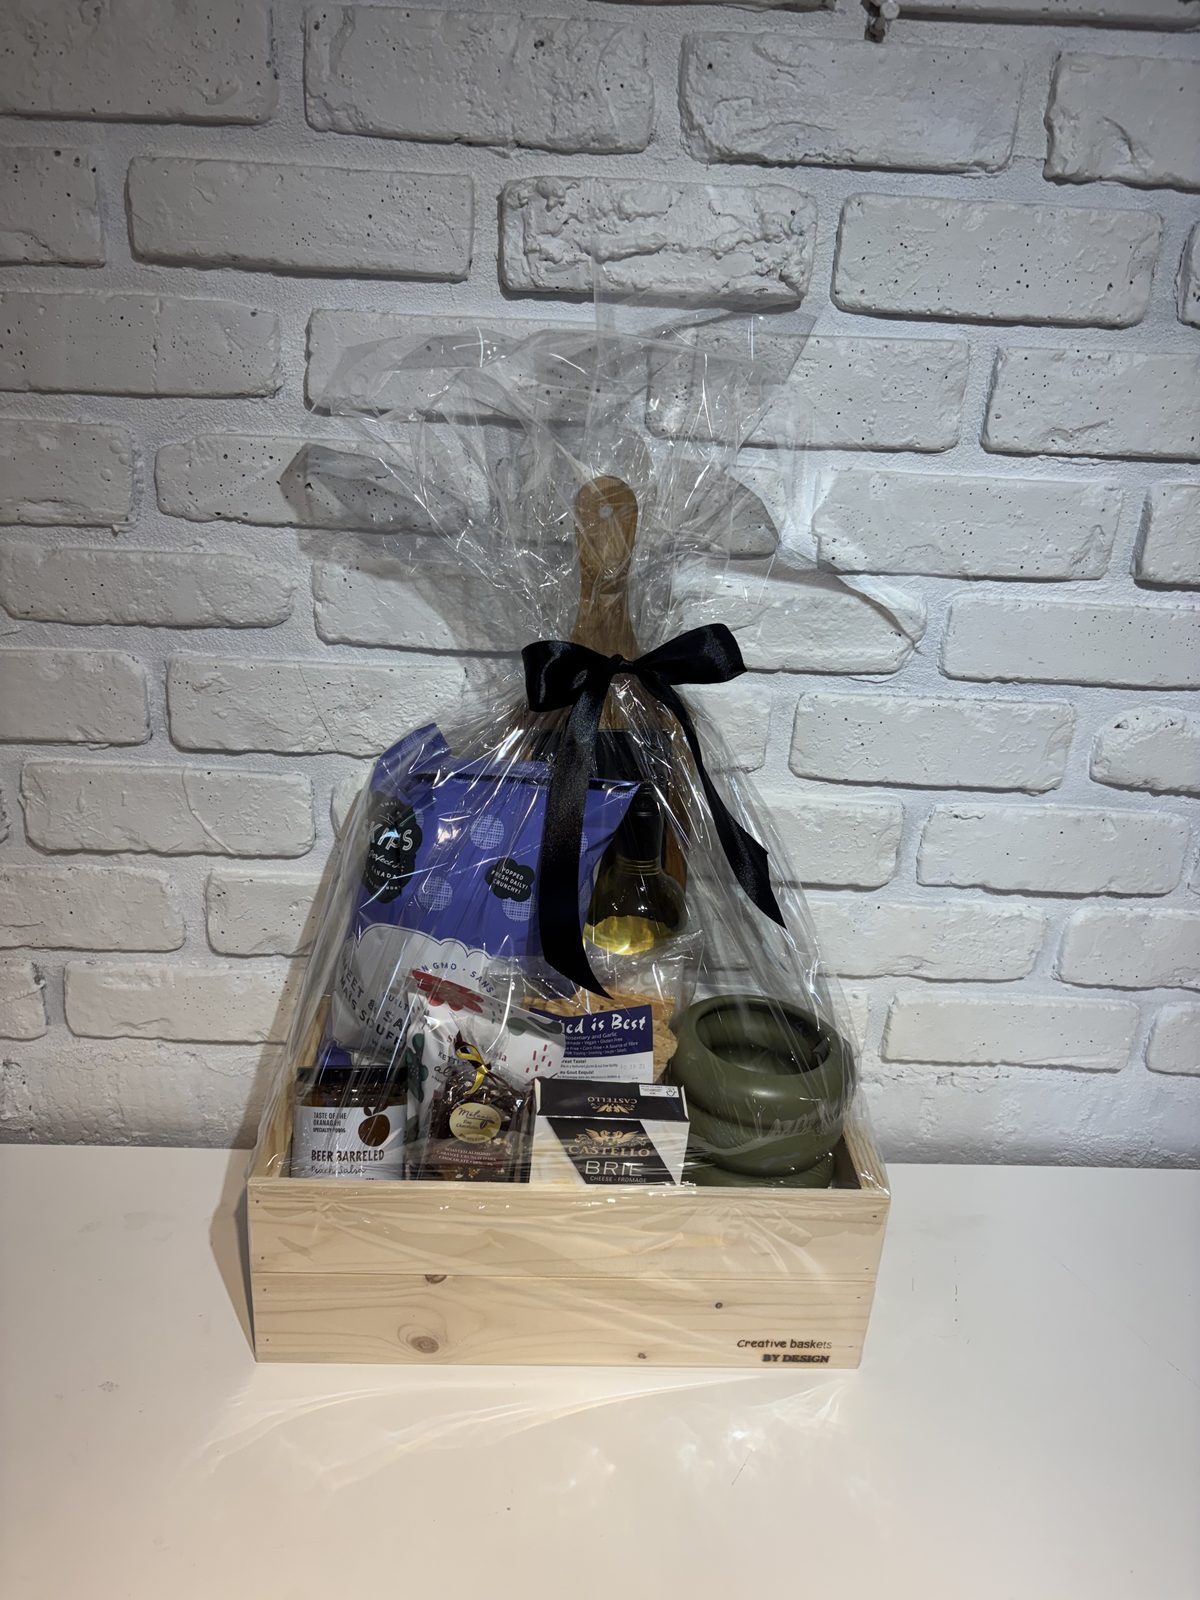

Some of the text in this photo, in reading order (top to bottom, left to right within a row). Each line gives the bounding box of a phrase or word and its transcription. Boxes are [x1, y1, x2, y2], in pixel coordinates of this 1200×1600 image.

[510, 879, 529, 890] DAILY!
[591, 1017, 605, 1031] is
[611, 1013, 646, 1031] Best
[587, 1096, 638, 1105] CASTELLO
[311, 1150, 385, 1162] BEER BARRELED
[568, 1145, 650, 1157] CASTELLO
[585, 1160, 643, 1176] BRIE
[737, 1339, 832, 1349] Creative baskets
[762, 1354, 830, 1363] BY DESIGN
